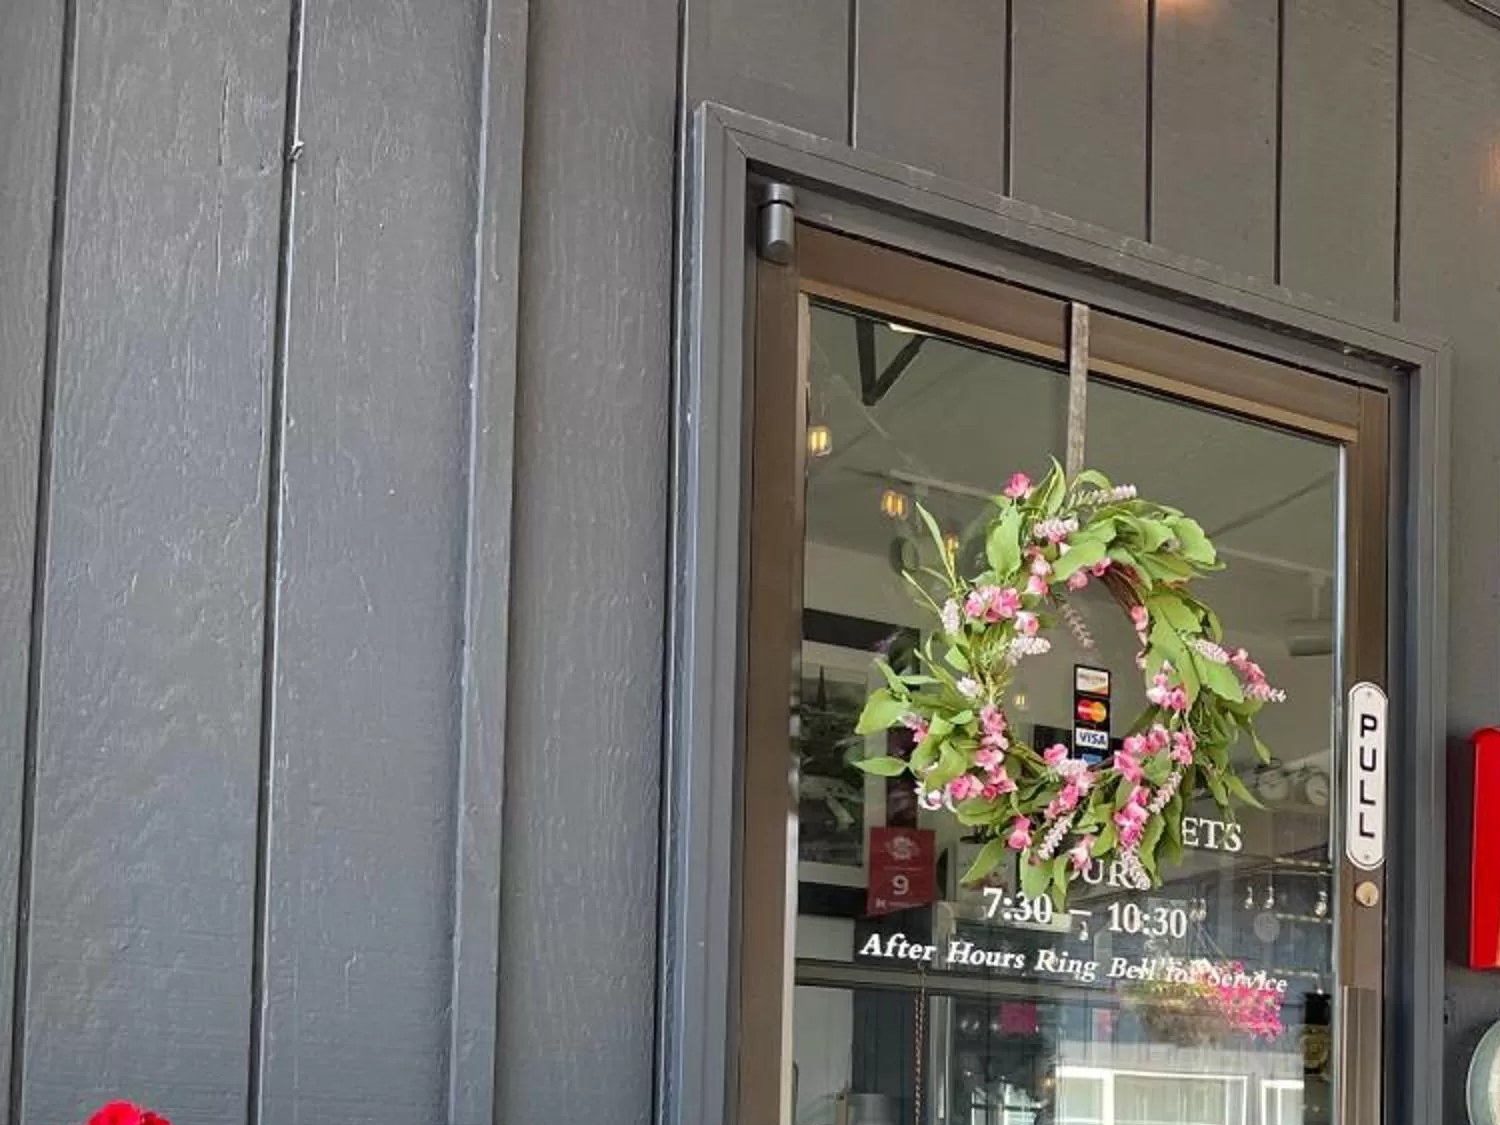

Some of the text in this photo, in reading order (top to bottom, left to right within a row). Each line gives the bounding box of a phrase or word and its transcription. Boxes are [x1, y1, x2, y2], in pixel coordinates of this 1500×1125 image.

[1080, 731, 1106, 746] VISA
[1359, 713, 1378, 839] PULL
[1181, 816, 1243, 852] ETS
[982, 886, 1053, 923] 7:30
[1107, 901, 1188, 939] 10:30
[859, 932, 938, 961] After
[945, 940, 1026, 970] Hours
[1033, 948, 1100, 983] Ring
[1106, 957, 1155, 981] Bell
[1207, 966, 1289, 993] Service
